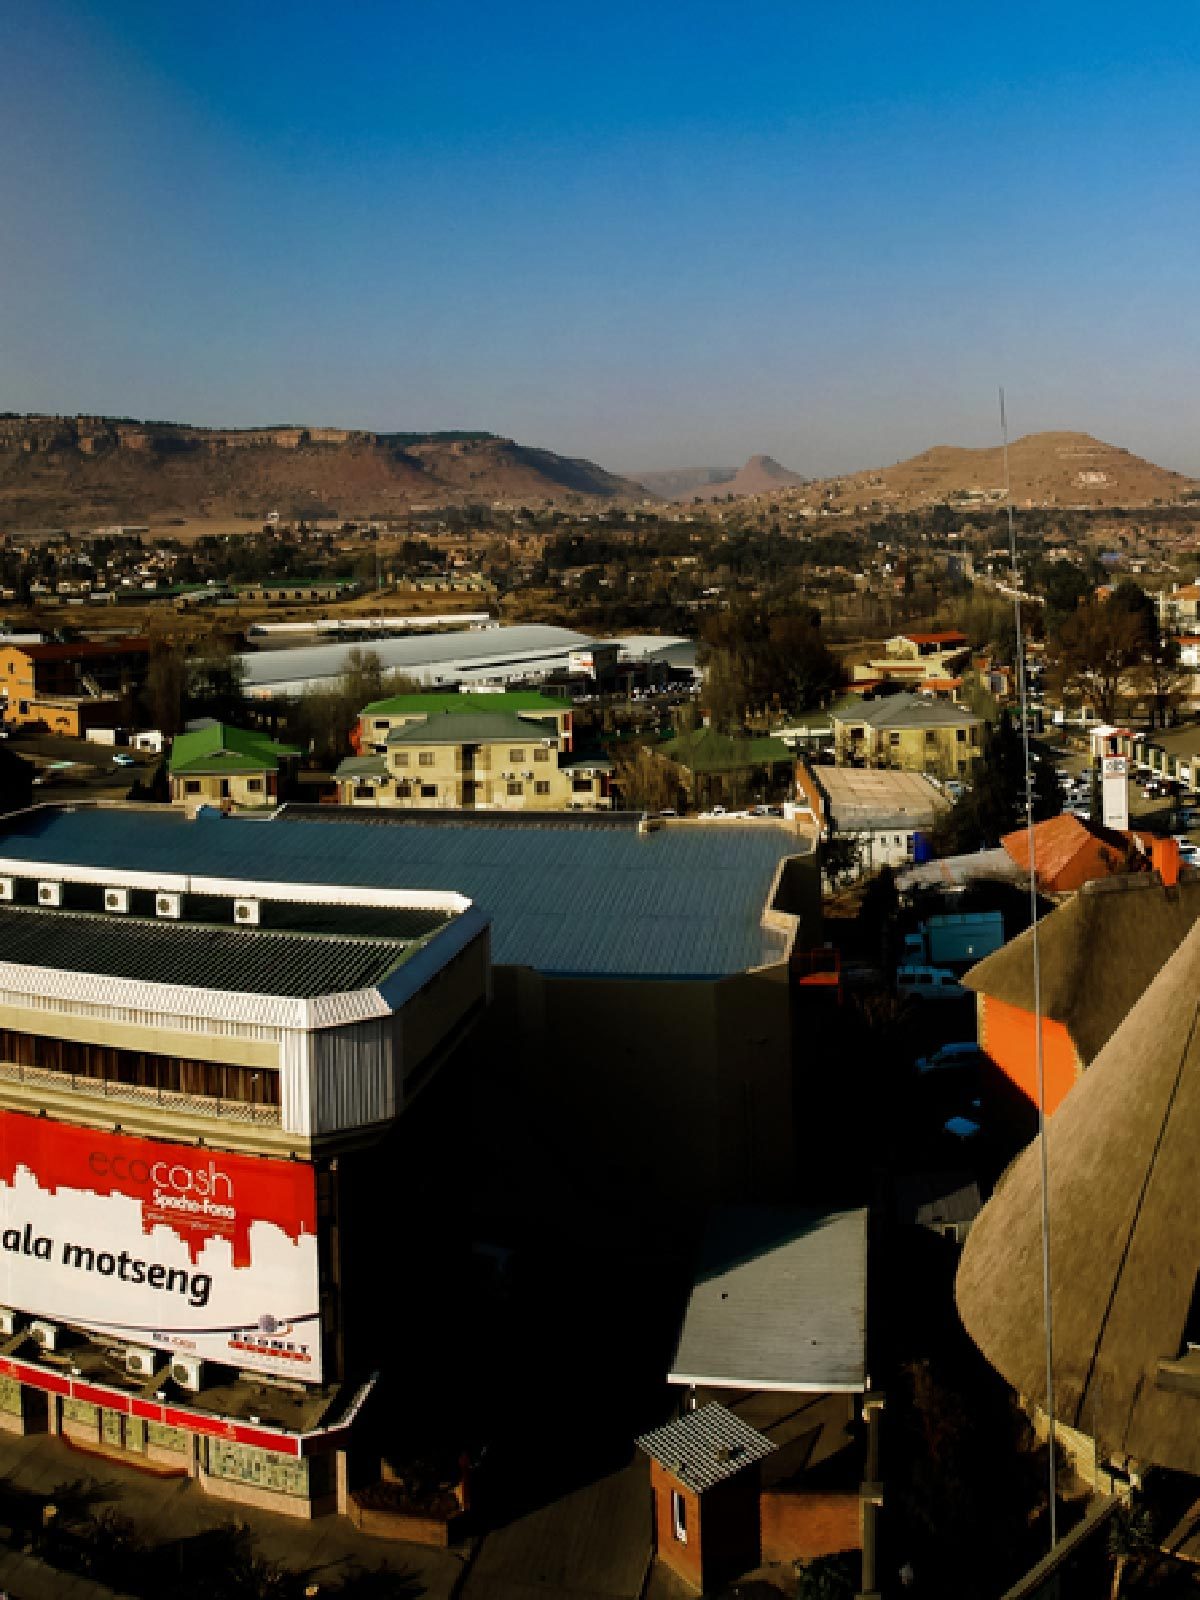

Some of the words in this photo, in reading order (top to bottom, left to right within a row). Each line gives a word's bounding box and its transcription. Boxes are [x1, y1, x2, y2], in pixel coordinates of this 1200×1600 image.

[88, 1150, 234, 1199] ecocash
[2, 1223, 53, 1260] ala
[61, 1241, 213, 1306] motseng
